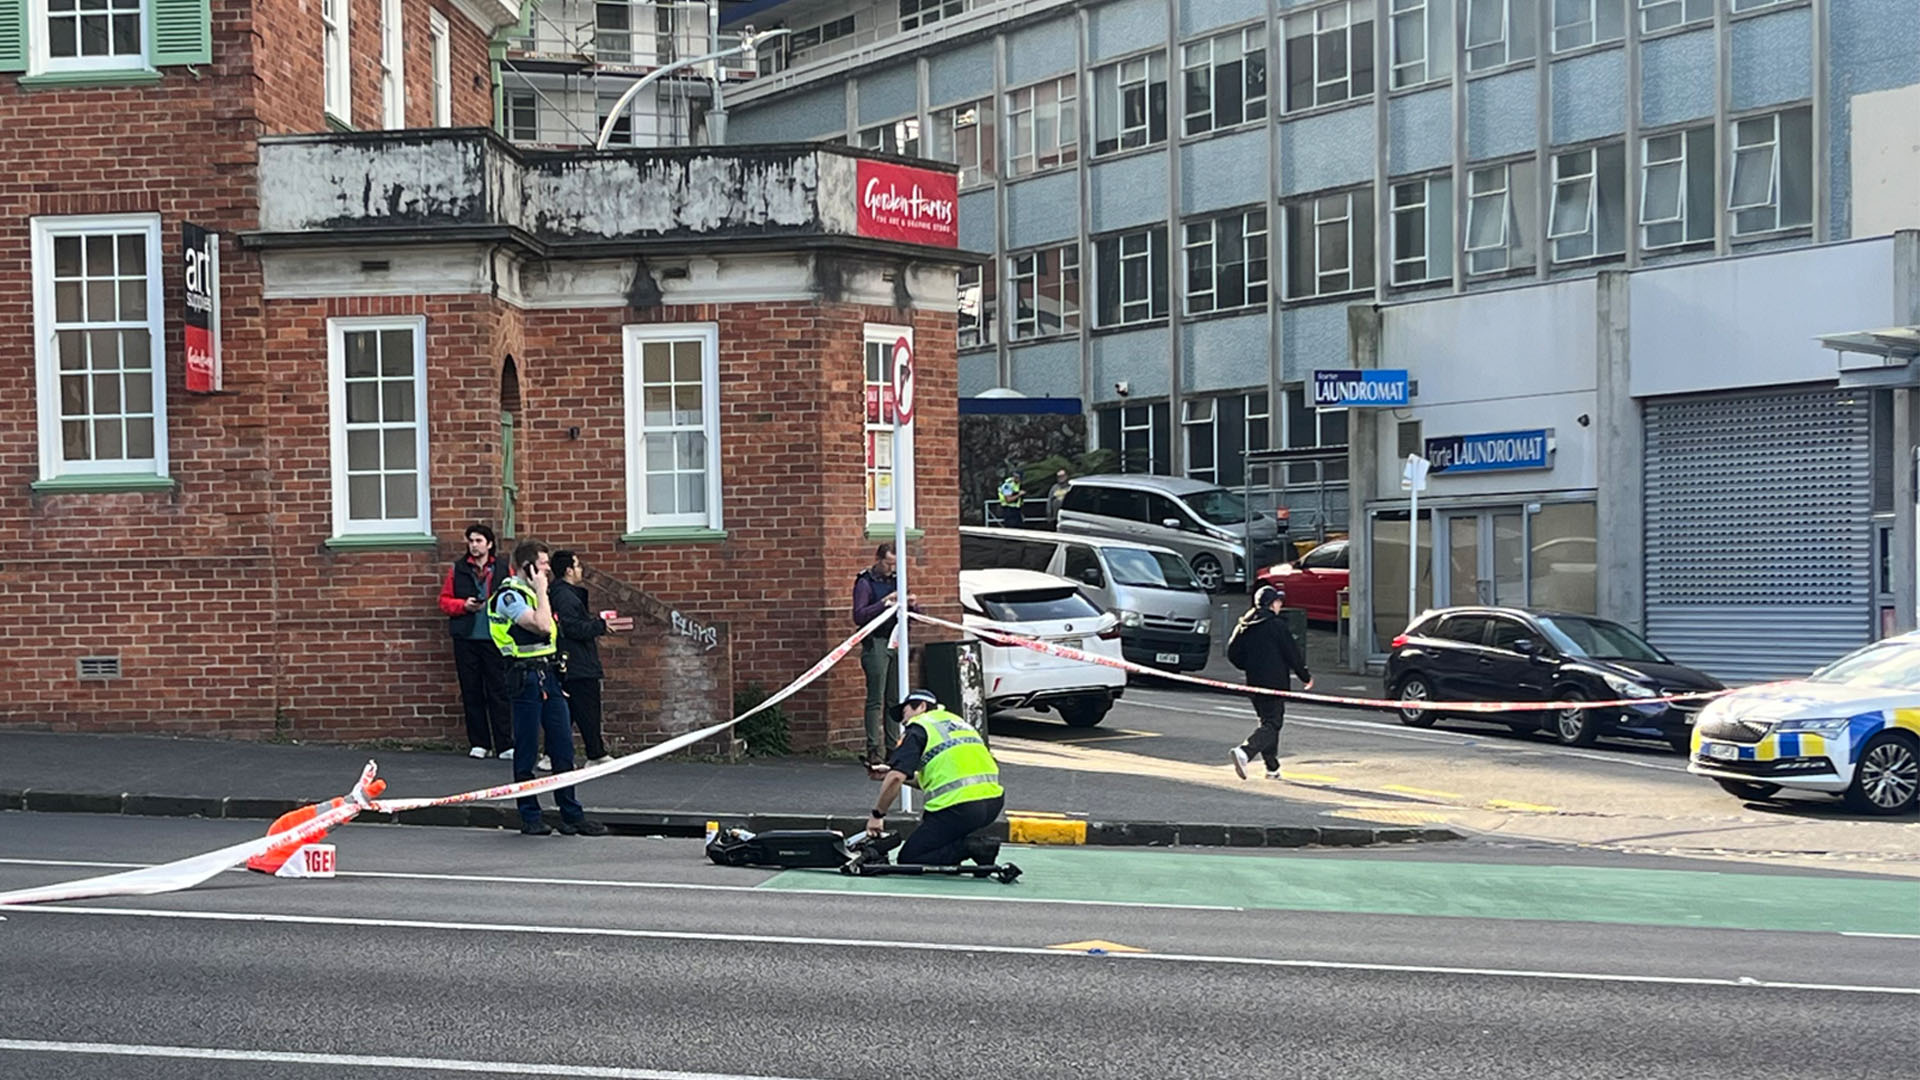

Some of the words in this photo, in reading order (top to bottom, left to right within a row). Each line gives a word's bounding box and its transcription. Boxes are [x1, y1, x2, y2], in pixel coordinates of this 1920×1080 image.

[908, 184, 952, 224] Harris
[185, 242, 211, 296] art
[1315, 381, 1405, 401] LAUNDROMAT
[1429, 443, 1453, 468] forte
[1453, 437, 1544, 465] LAUNDROMAT
